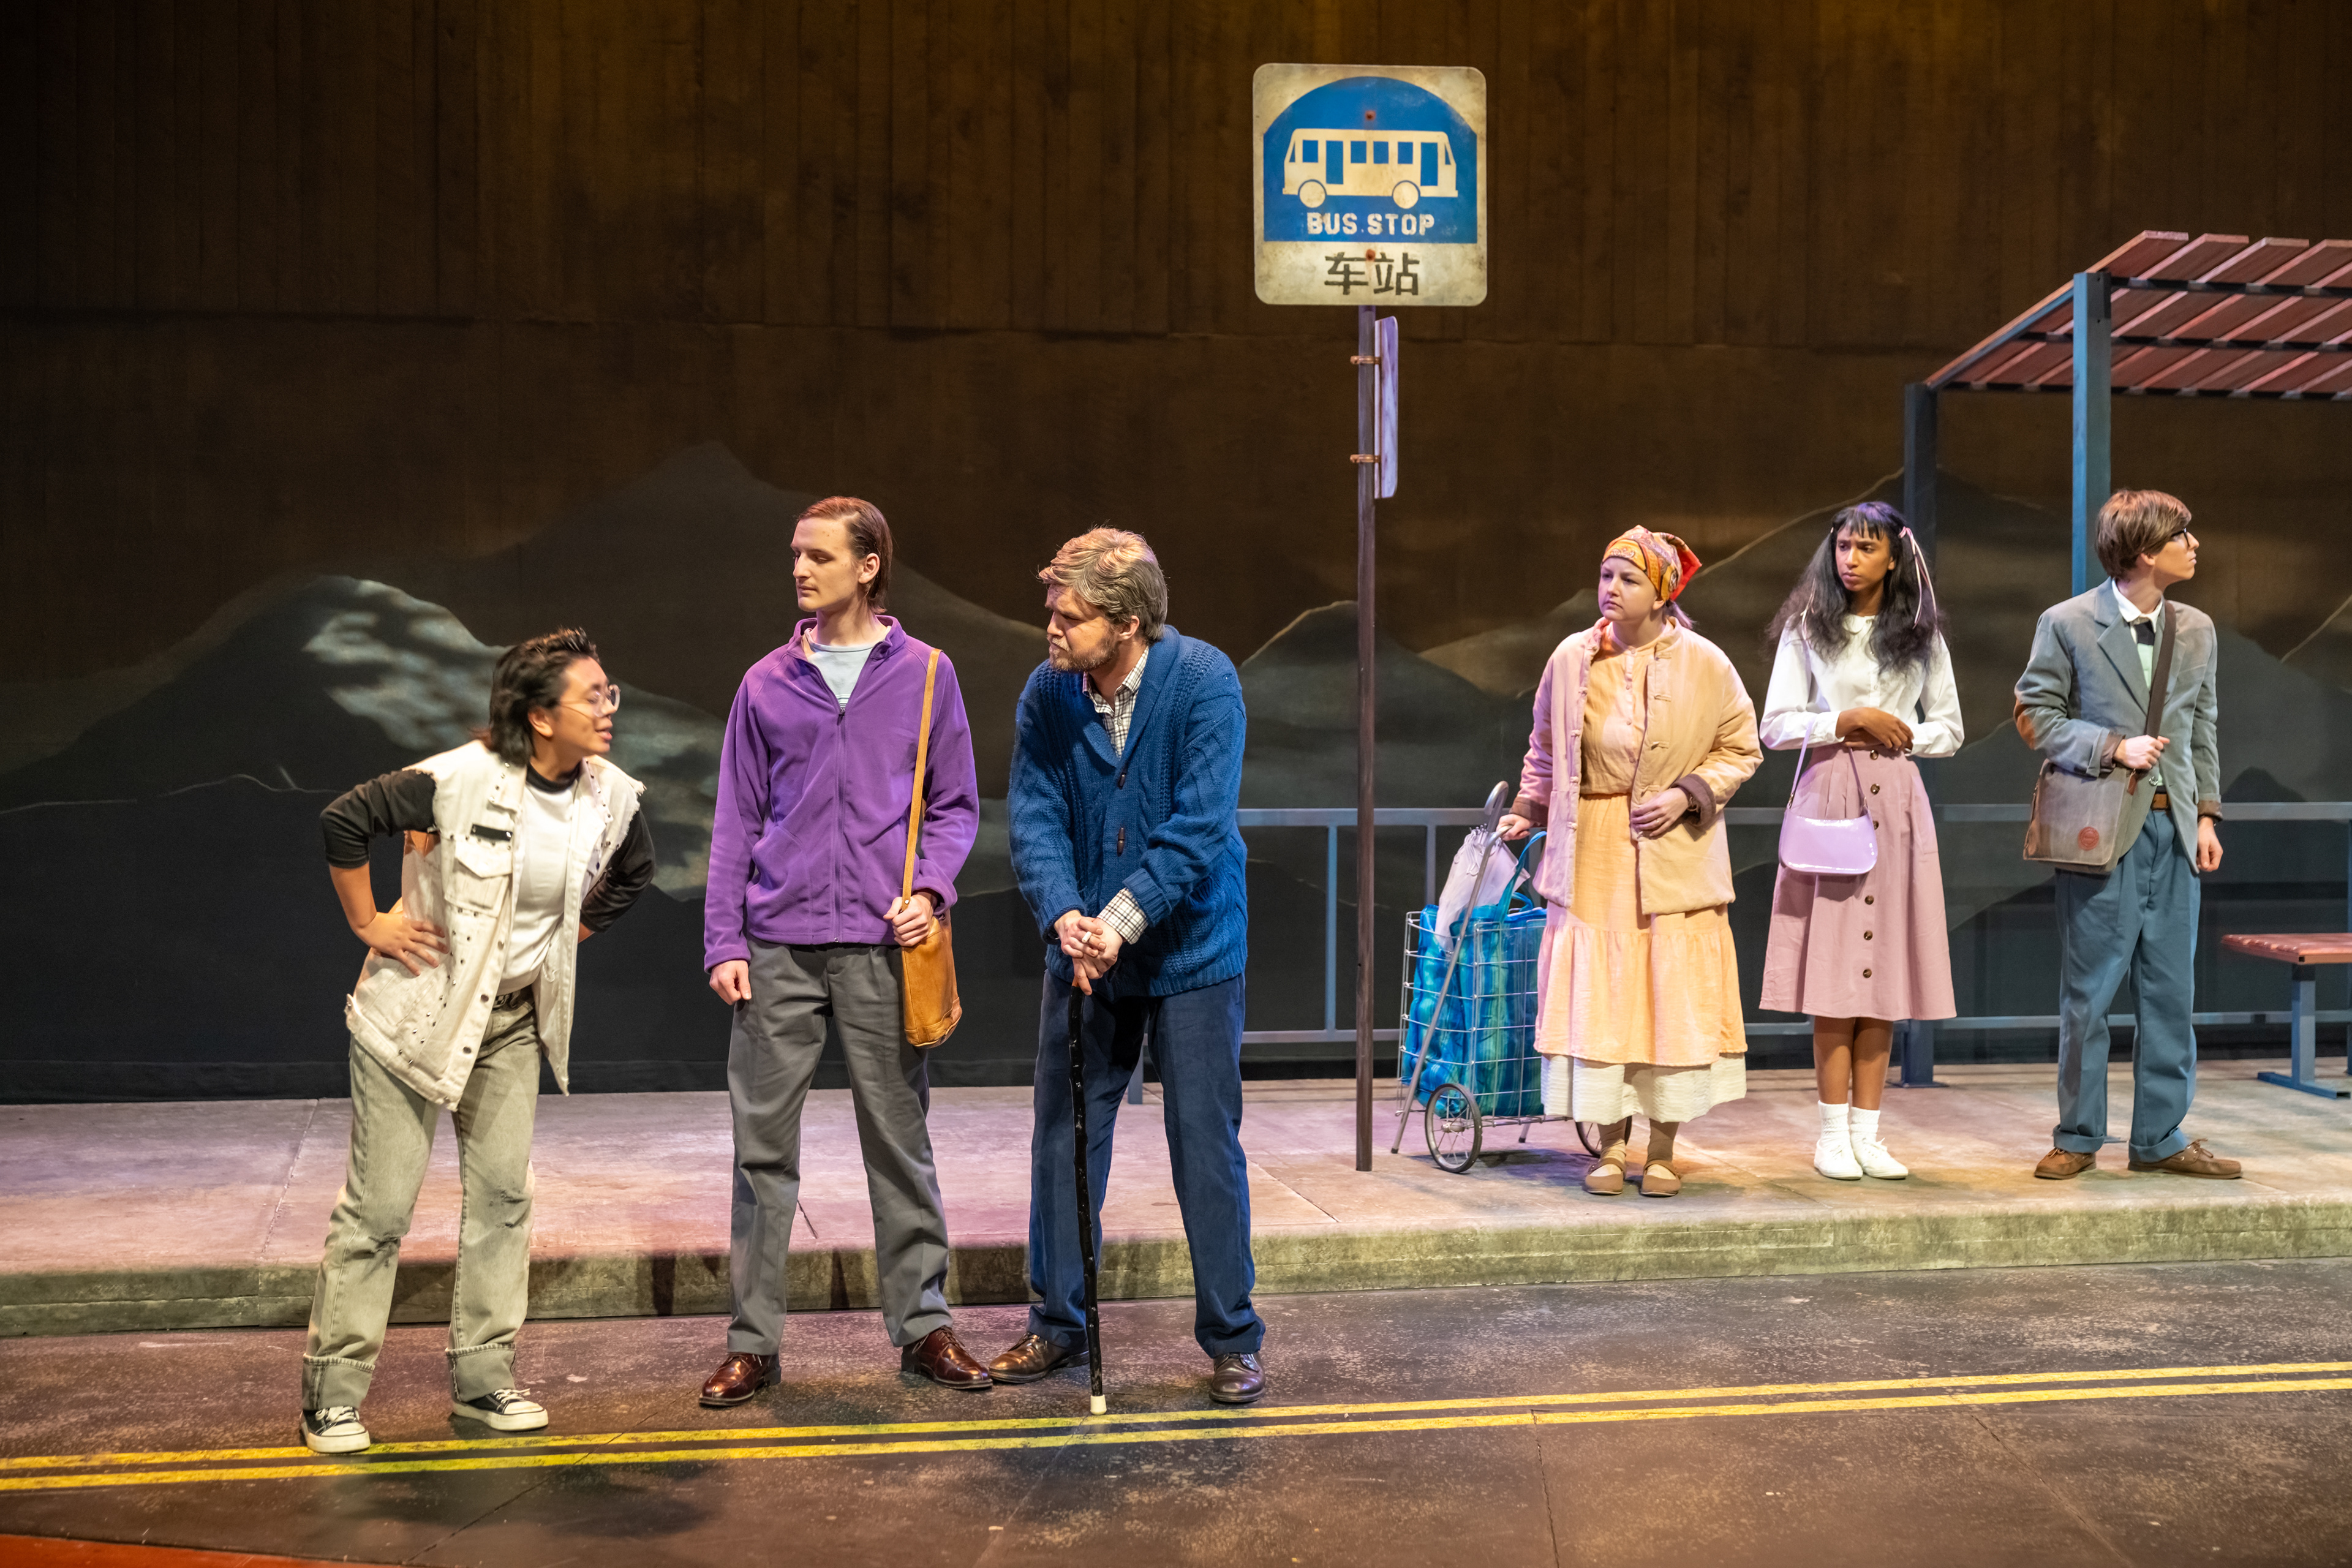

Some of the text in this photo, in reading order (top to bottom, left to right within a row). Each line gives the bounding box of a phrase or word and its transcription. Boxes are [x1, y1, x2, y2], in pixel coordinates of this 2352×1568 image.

[1307, 212, 1435, 236] BUS STOP
[1324, 251, 1420, 296] 车站
